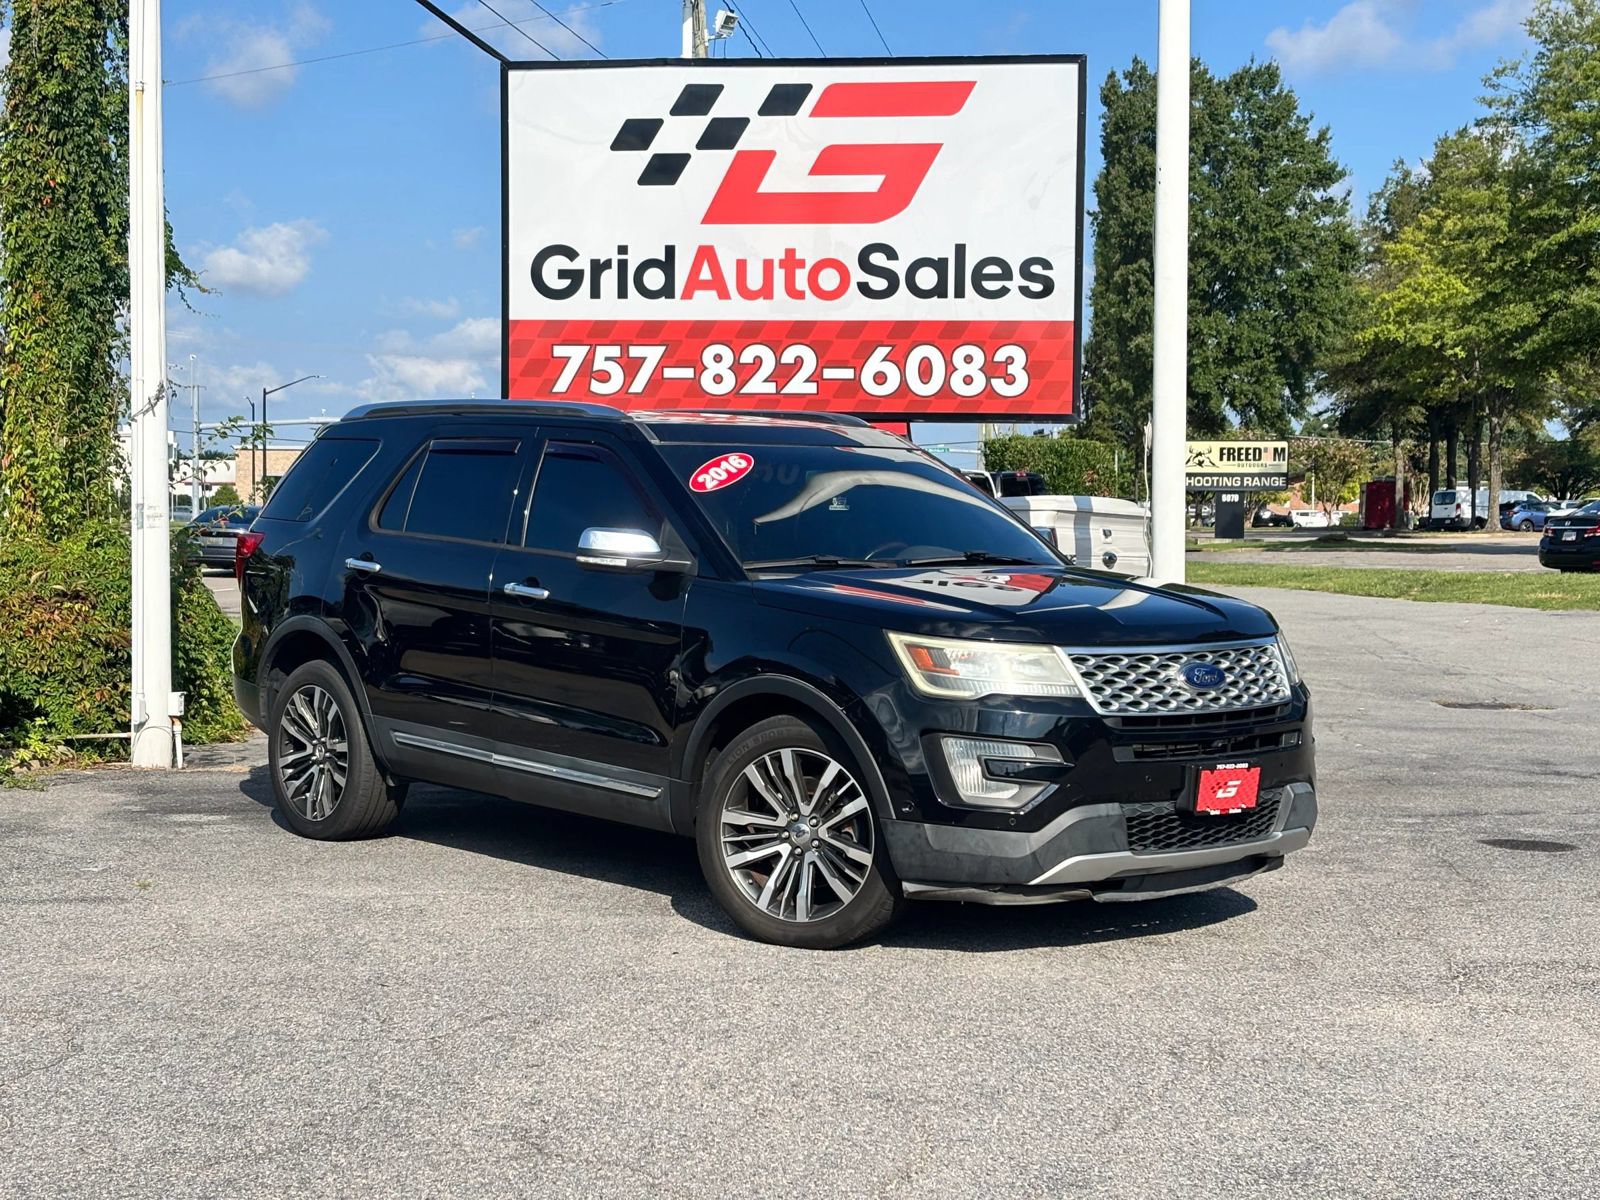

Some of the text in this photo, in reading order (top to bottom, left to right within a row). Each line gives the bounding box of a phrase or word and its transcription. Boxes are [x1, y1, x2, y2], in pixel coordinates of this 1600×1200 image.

[551, 343, 1030, 398] 757-822-6083
[1220, 447, 1286, 461] FREEDM
[697, 455, 748, 489] 2016
[1186, 476, 1286, 487] HOOTING RANGE
[1193, 667, 1218, 684] Ford
